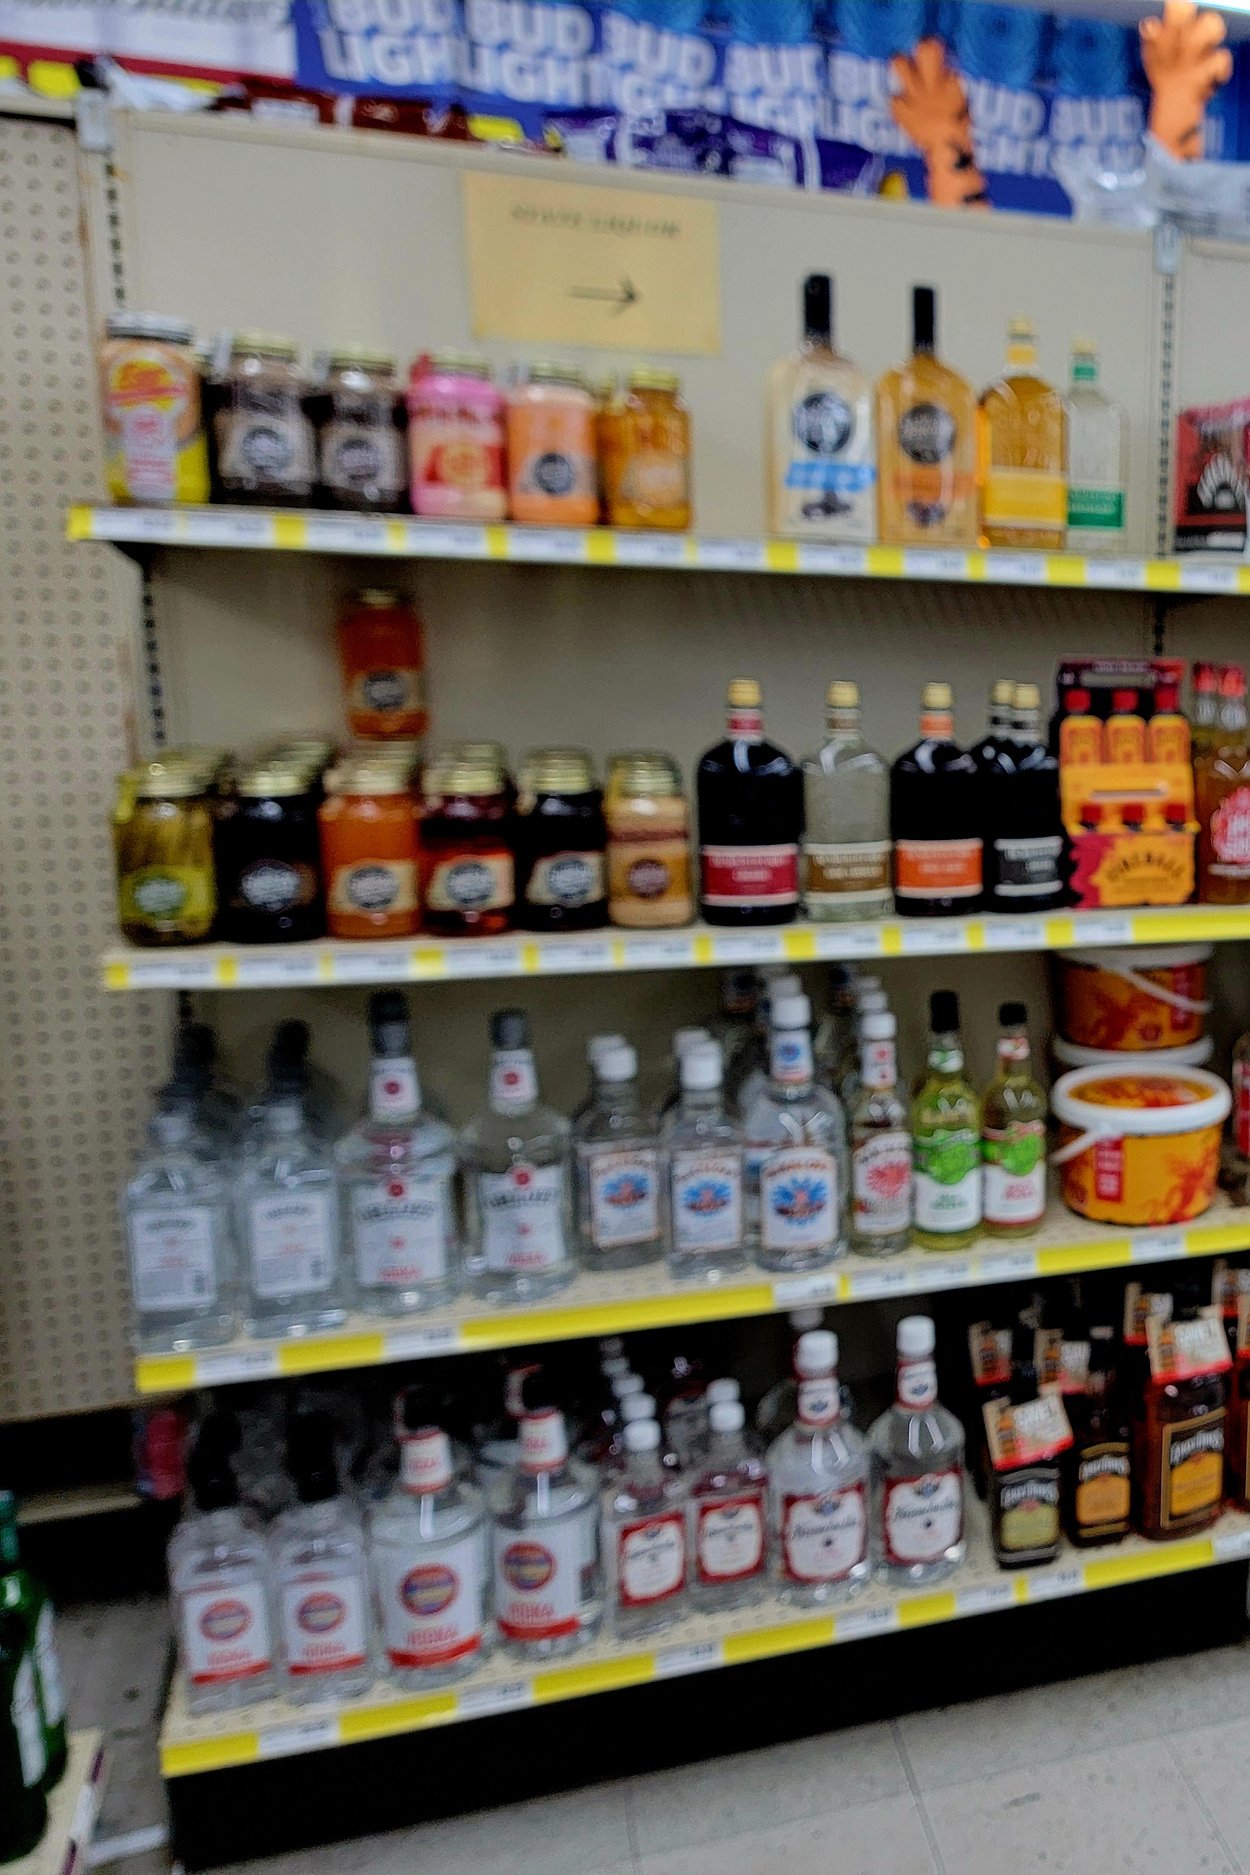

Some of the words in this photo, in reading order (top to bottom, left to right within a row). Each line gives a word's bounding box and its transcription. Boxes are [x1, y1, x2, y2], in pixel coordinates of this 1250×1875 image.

[318, 28, 460, 86] LIGH
[465, 2, 595, 57] BUD
[602, 12, 716, 88] BUD
[970, 76, 1047, 137] UD
